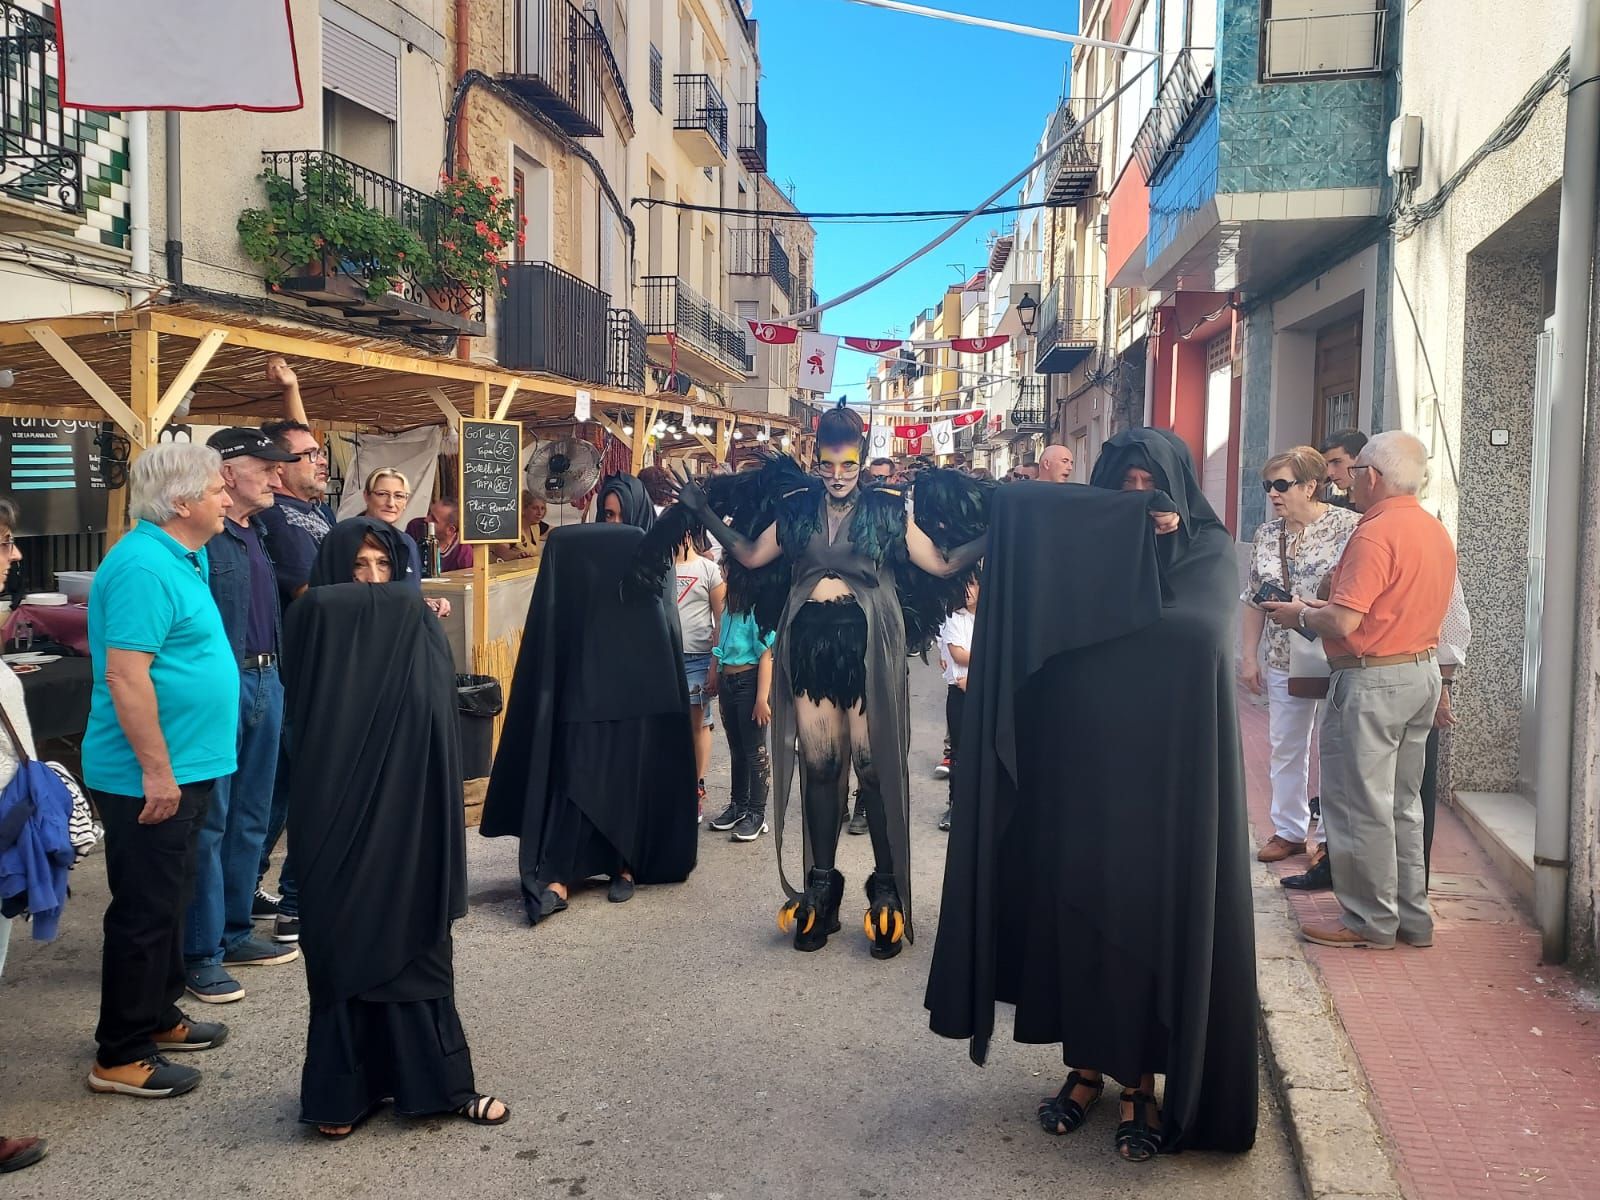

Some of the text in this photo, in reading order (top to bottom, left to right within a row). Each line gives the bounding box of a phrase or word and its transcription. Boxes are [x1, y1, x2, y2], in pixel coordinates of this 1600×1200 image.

[485, 428, 496, 440] de
[466, 499, 487, 512] Plat
[479, 515, 496, 530] 4€
